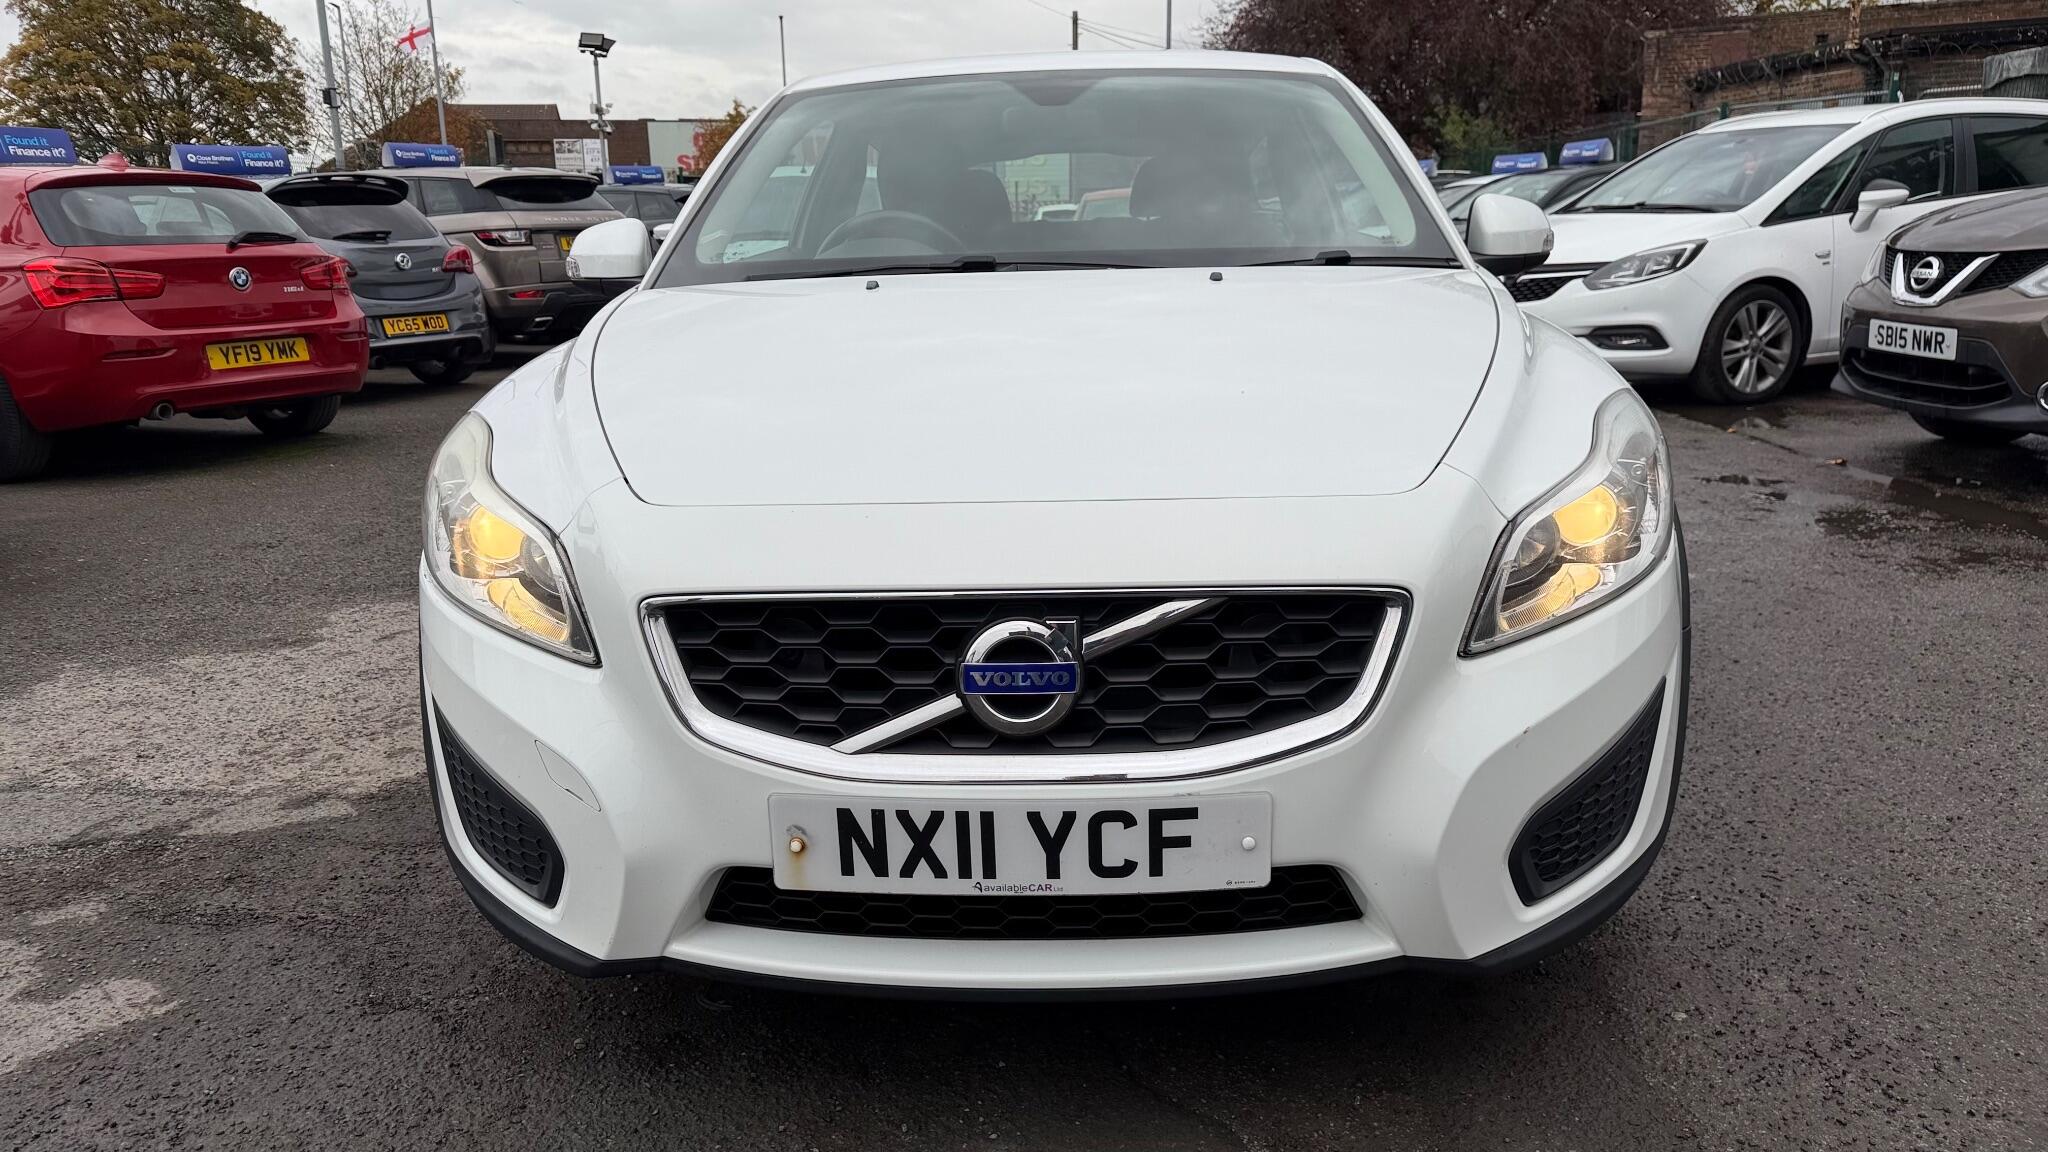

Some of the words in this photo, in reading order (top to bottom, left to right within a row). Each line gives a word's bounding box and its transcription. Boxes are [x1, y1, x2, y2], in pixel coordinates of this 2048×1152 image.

[4, 134, 39, 146] Found
[40, 136, 49, 146] it
[8, 145, 51, 157] Finance
[51, 147, 66, 158] it?
[242, 150, 265, 159] Found
[265, 151, 272, 159] it
[245, 159, 274, 167] Finance
[274, 159, 284, 168] it?
[387, 318, 421, 332] YC65
[421, 316, 444, 330] WOD
[1877, 324, 1908, 349] SB15
[1912, 328, 1945, 354] NWR
[219, 343, 262, 365] YF19
[264, 340, 299, 360] YMK
[969, 671, 1071, 687] VOLVO
[836, 807, 998, 880] NX11
[1026, 806, 1199, 880] YCF
